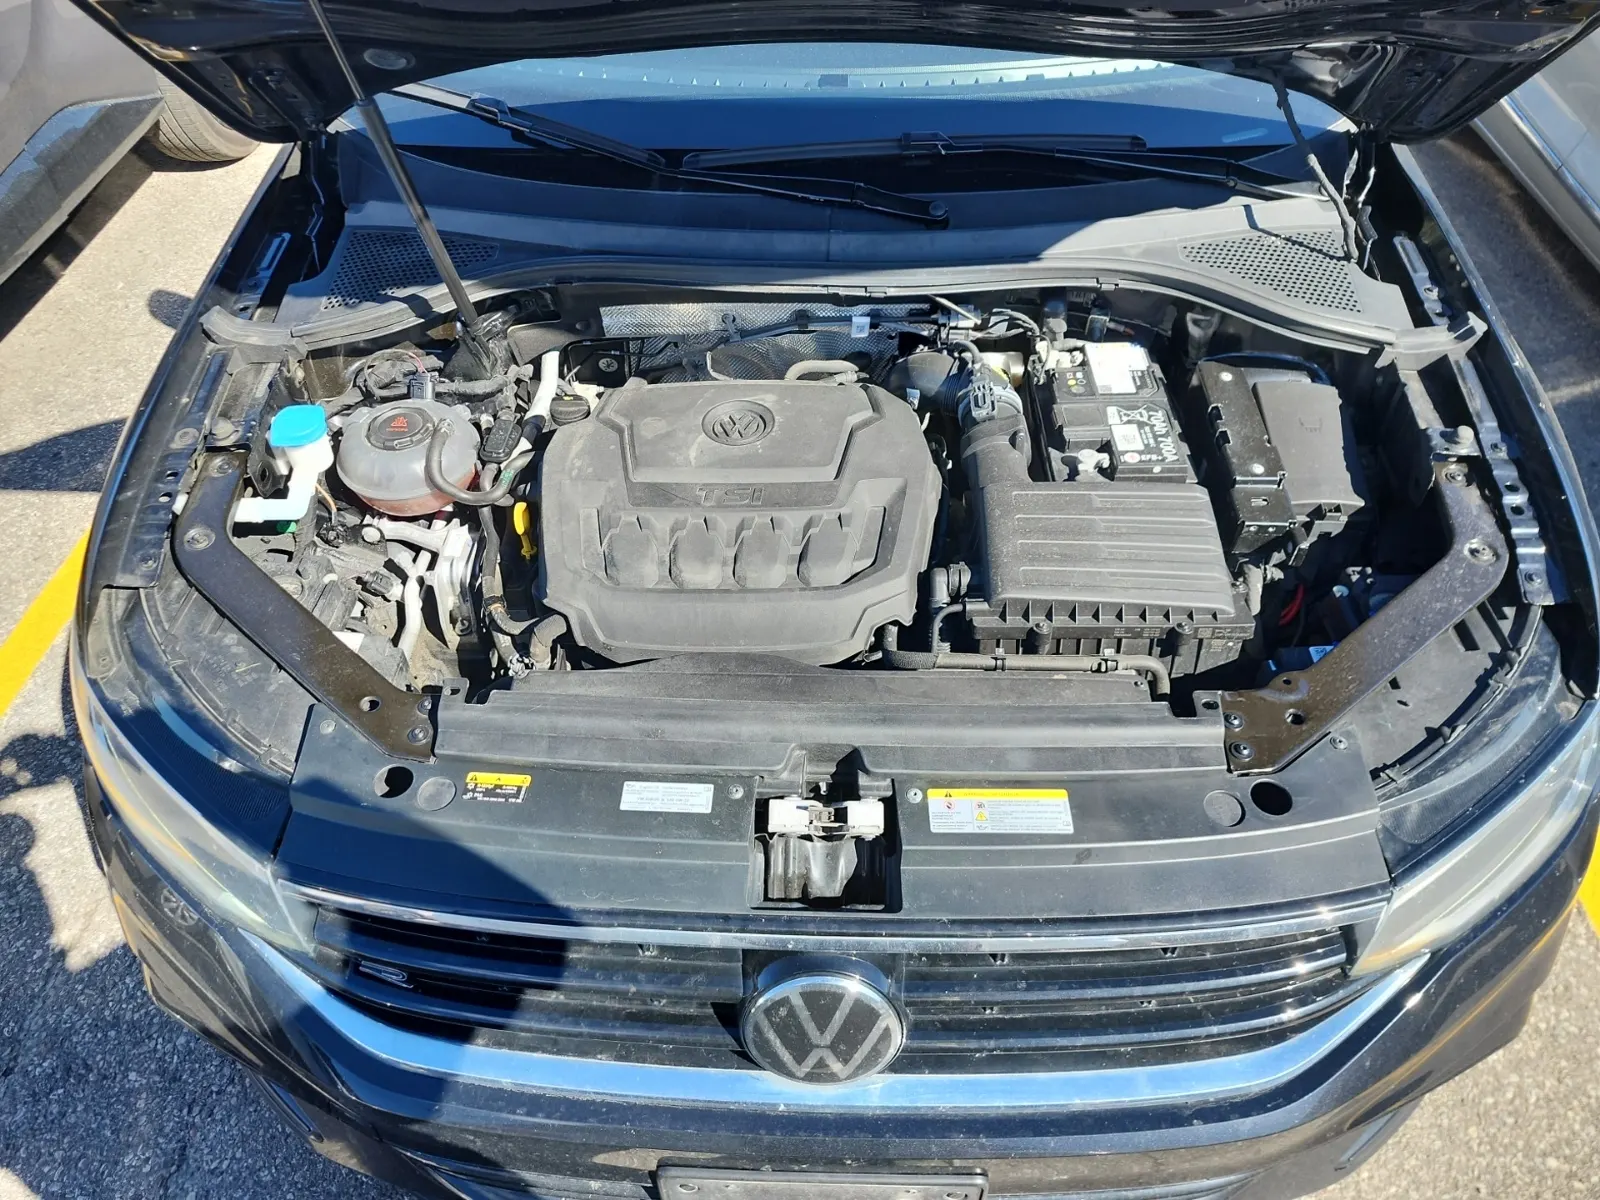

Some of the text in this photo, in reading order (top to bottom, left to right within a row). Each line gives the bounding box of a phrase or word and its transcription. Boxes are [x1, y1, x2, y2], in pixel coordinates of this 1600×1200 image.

[1148, 410, 1169, 435] 70Ah
[1157, 436, 1179, 462] 700A
[696, 487, 765, 505] TSI
[748, 981, 899, 1083] VW
